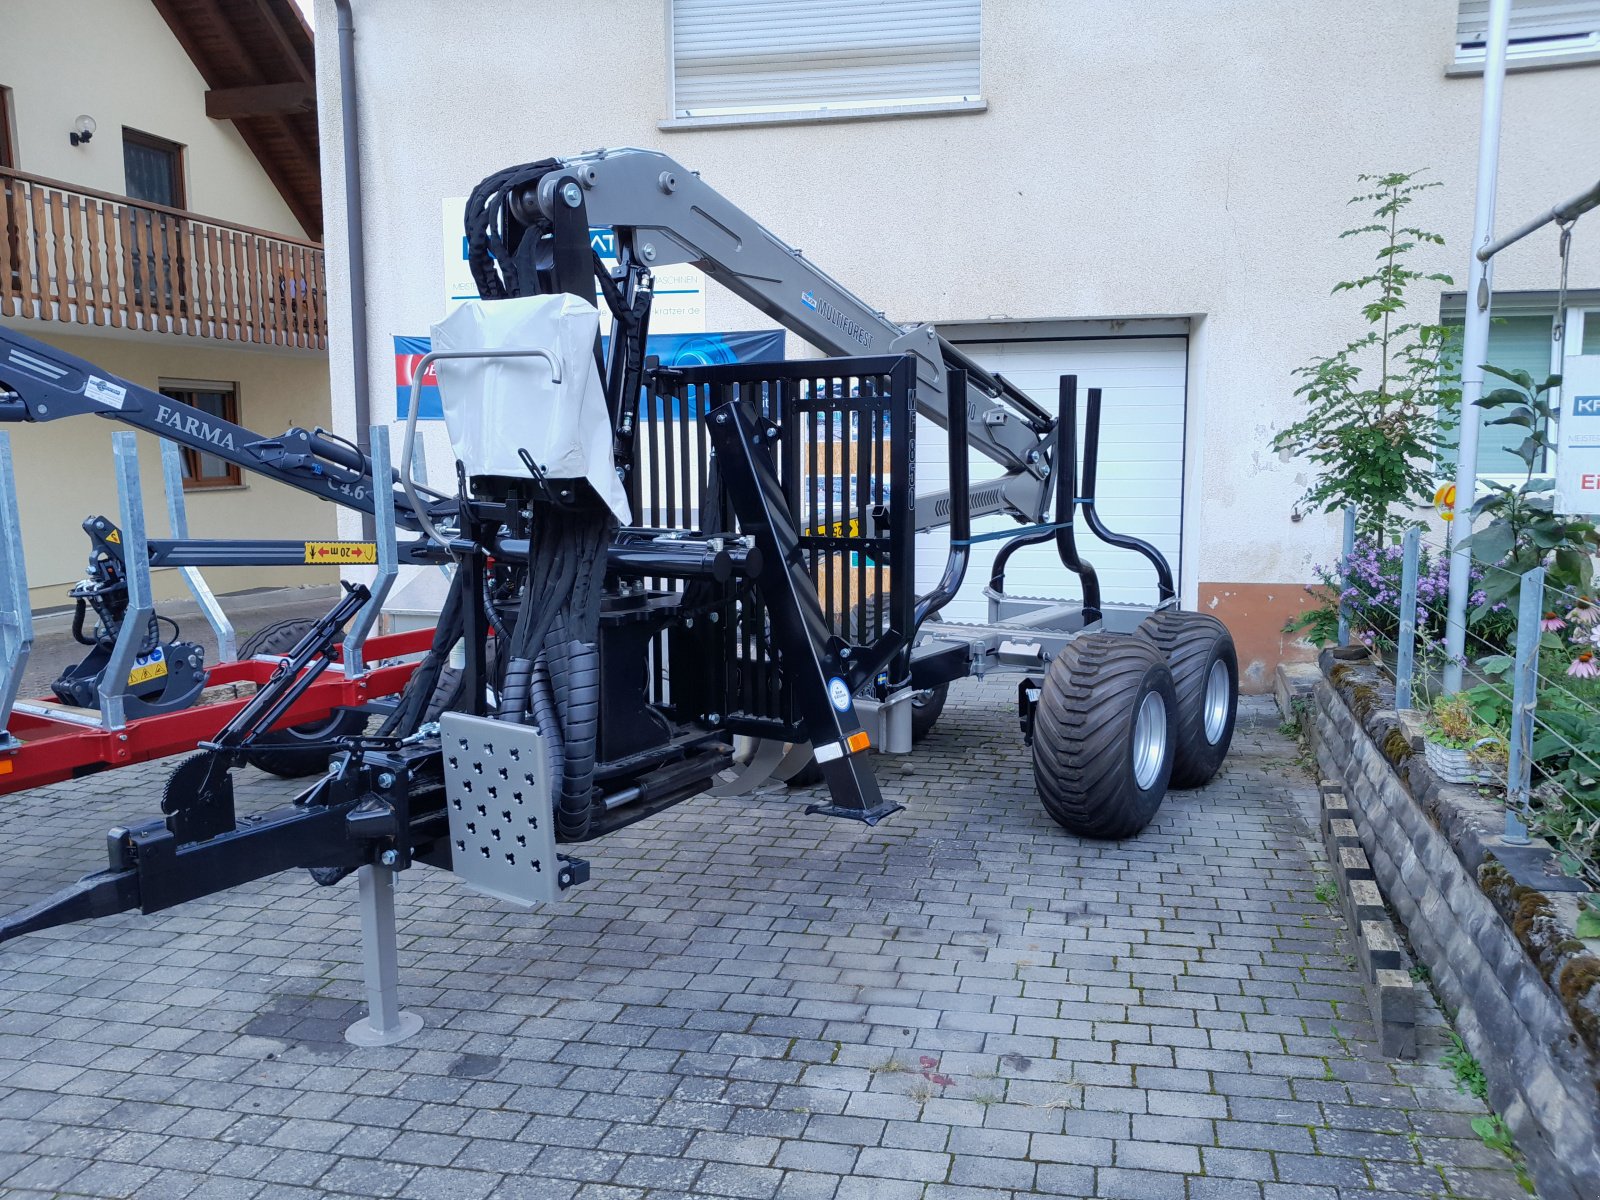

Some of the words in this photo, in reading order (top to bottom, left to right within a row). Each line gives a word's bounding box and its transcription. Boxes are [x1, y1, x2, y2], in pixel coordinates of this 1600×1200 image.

[817, 298, 874, 350] MULTIFOREST
[155, 404, 235, 451] FARMA
[330, 547, 339, 555] m
[340, 547, 351, 558] 20
